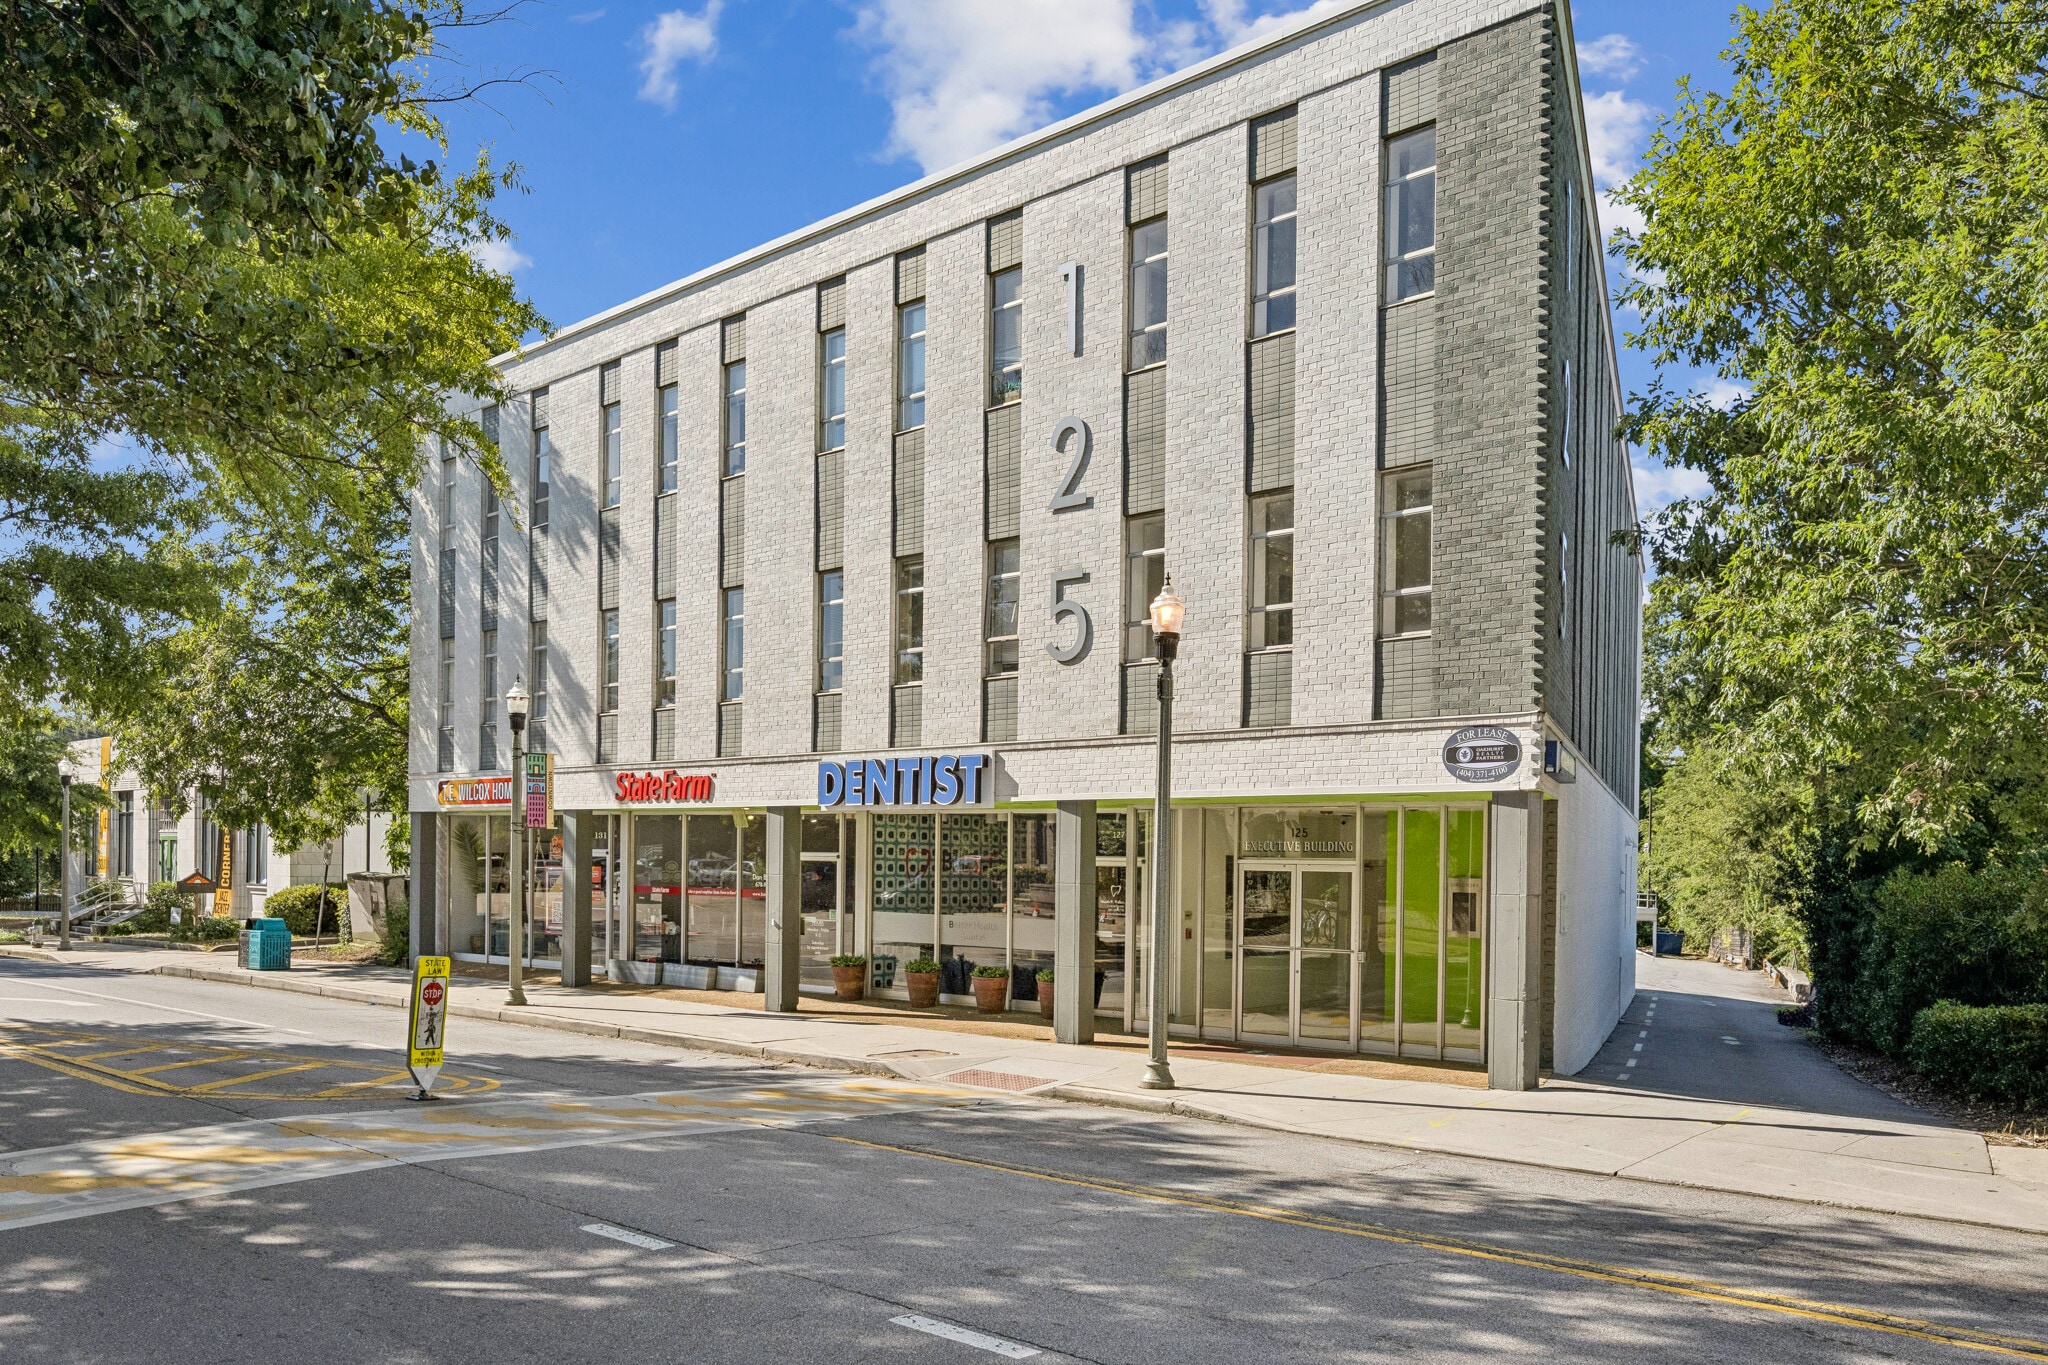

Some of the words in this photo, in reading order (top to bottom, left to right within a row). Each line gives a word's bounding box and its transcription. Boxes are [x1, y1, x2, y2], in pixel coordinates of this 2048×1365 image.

[1456, 730, 1476, 742] FOR
[1477, 728, 1509, 741] LEASE
[1456, 768, 1475, 779] (404)
[1475, 766, 1508, 778] 371-4100
[818, 755, 988, 807] DENTIST
[442, 784, 456, 801] T.E.
[458, 781, 490, 801] WILCOX
[491, 781, 513, 800] HOM
[594, 831, 607, 839] 131
[1113, 831, 1126, 839] 127
[1291, 827, 1309, 838] 125
[1244, 841, 1301, 853] EXECUTIVE
[1303, 841, 1354, 853] BUILDING
[219, 890, 229, 902] JAZZ
[425, 959, 446, 967] STATE
[423, 989, 443, 999] STOP
